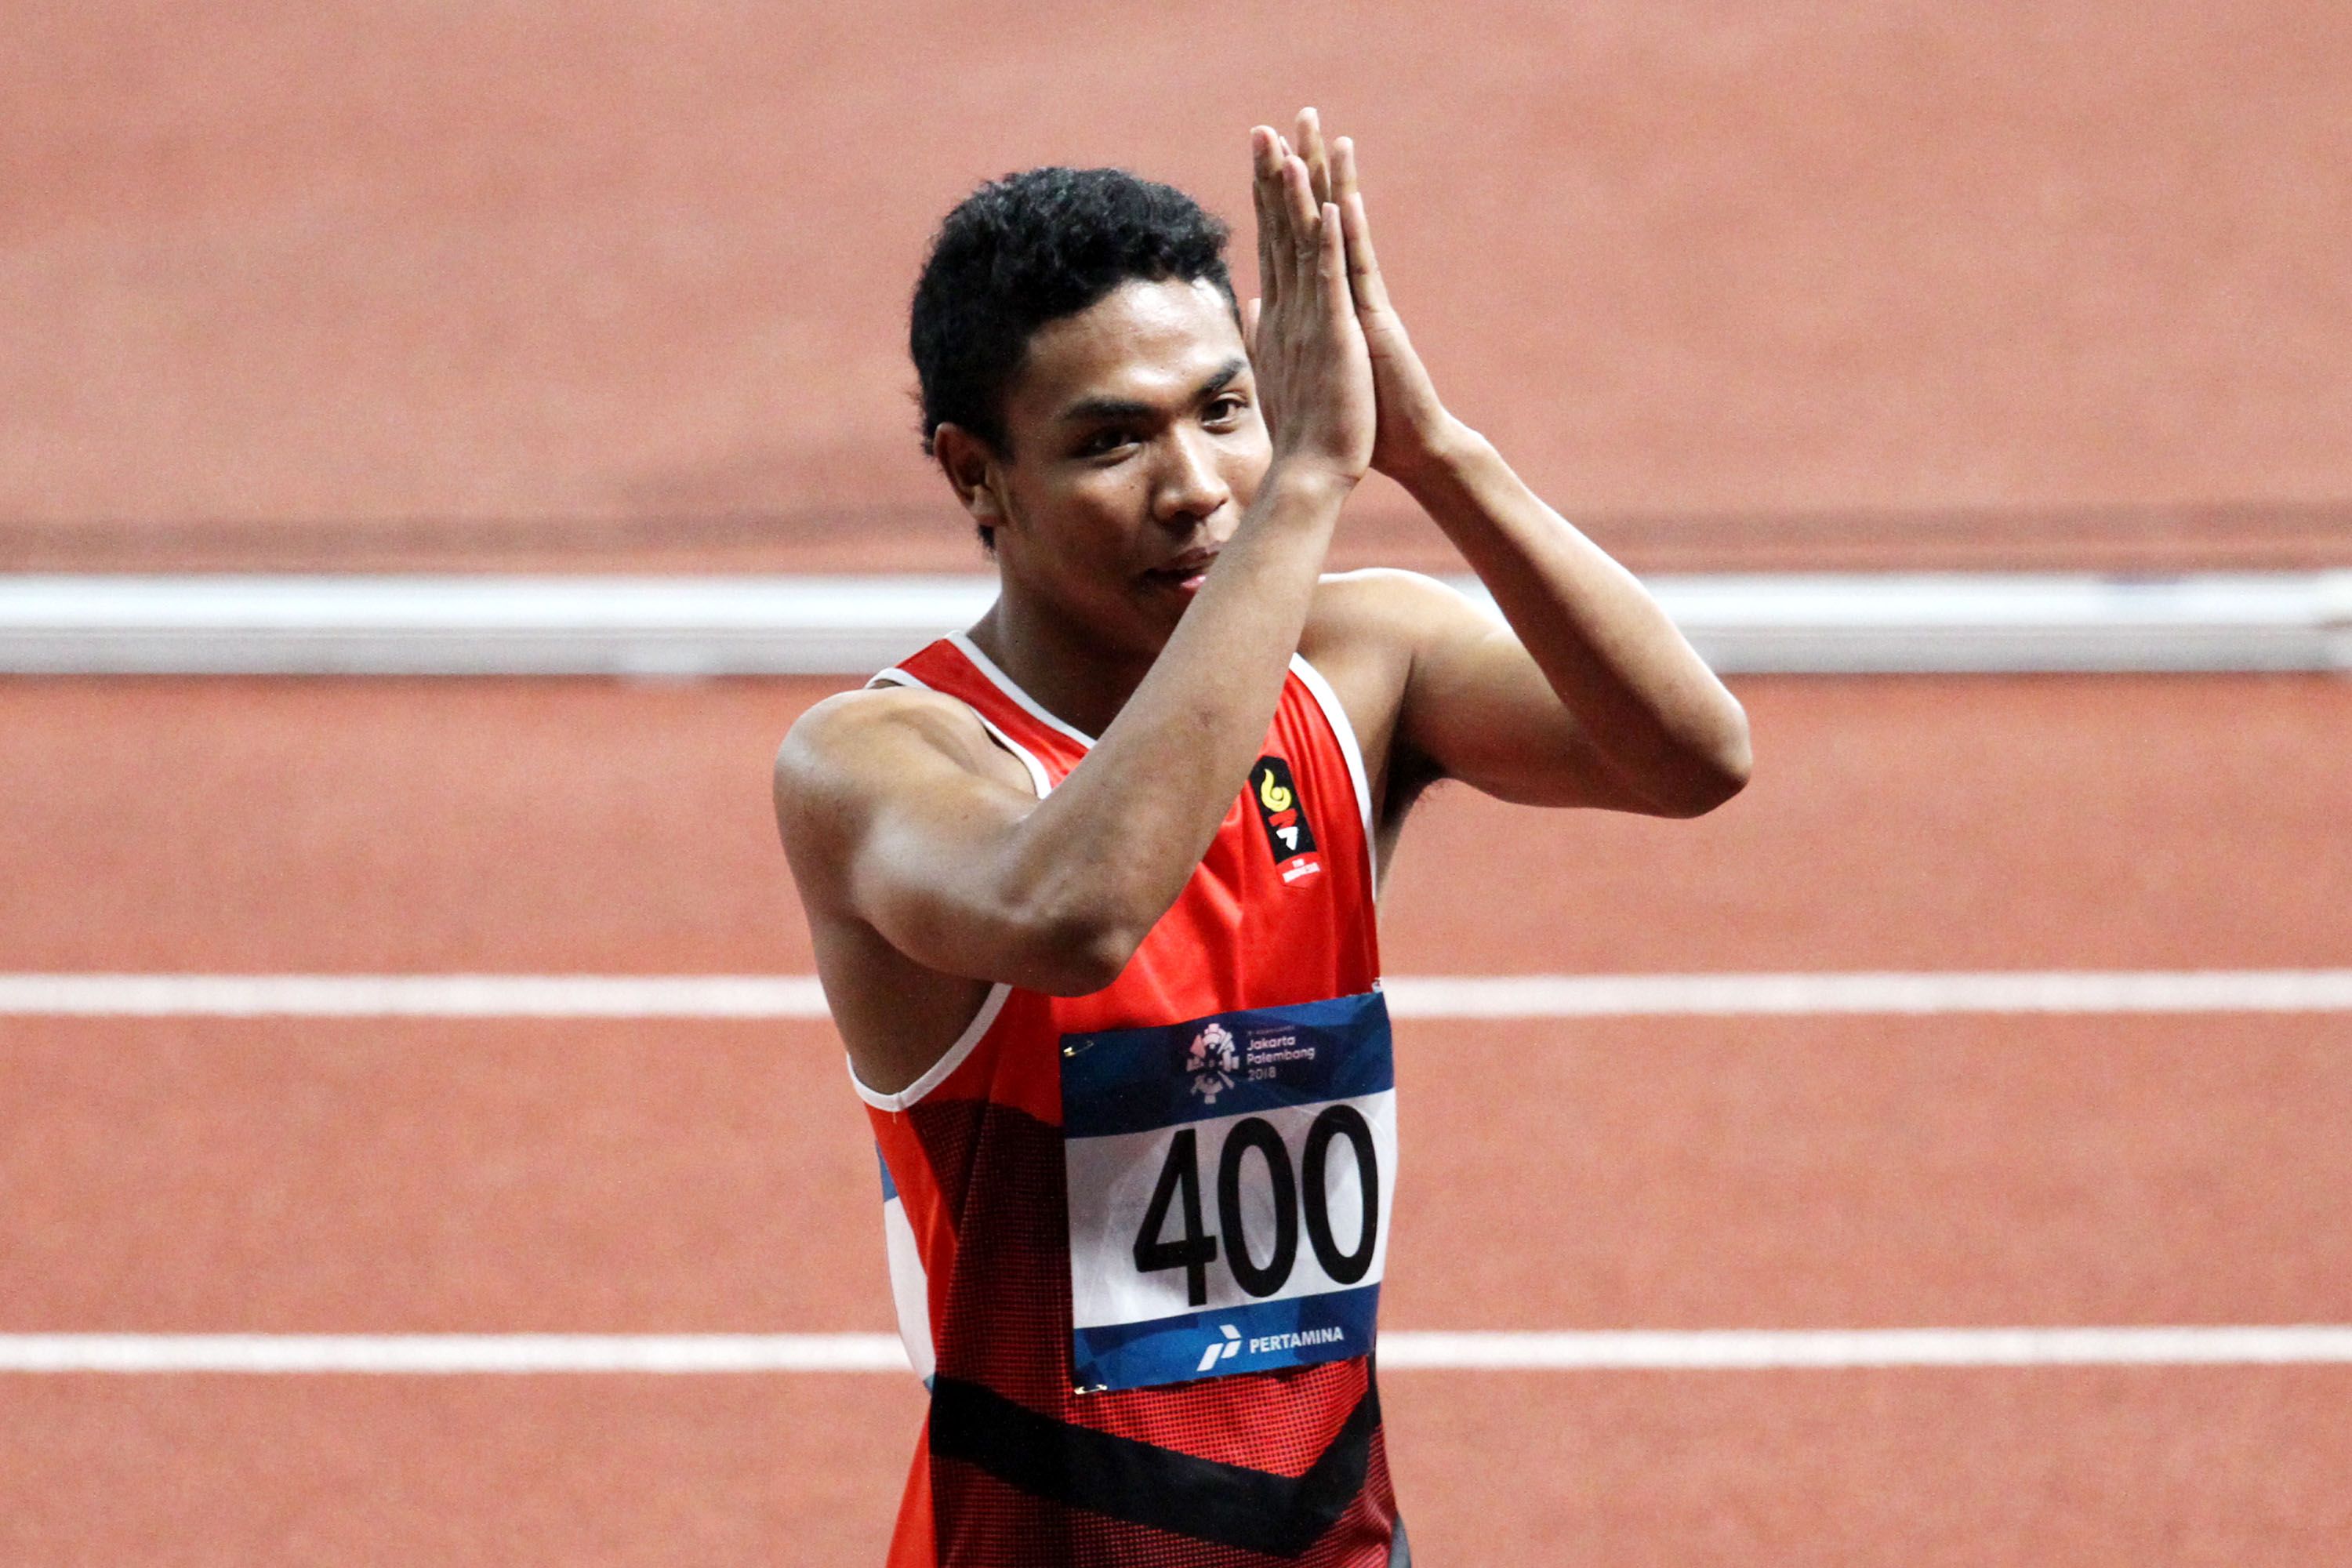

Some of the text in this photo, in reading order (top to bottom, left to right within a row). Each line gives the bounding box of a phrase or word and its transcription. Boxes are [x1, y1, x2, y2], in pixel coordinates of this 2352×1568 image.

[1247, 1036, 1296, 1051] Jakarta
[1247, 1047, 1315, 1065] Palembang
[1248, 1066, 1276, 1081] 2018
[1133, 1105, 1379, 1307] 400
[1250, 1327, 1344, 1354] PERTAMINA
